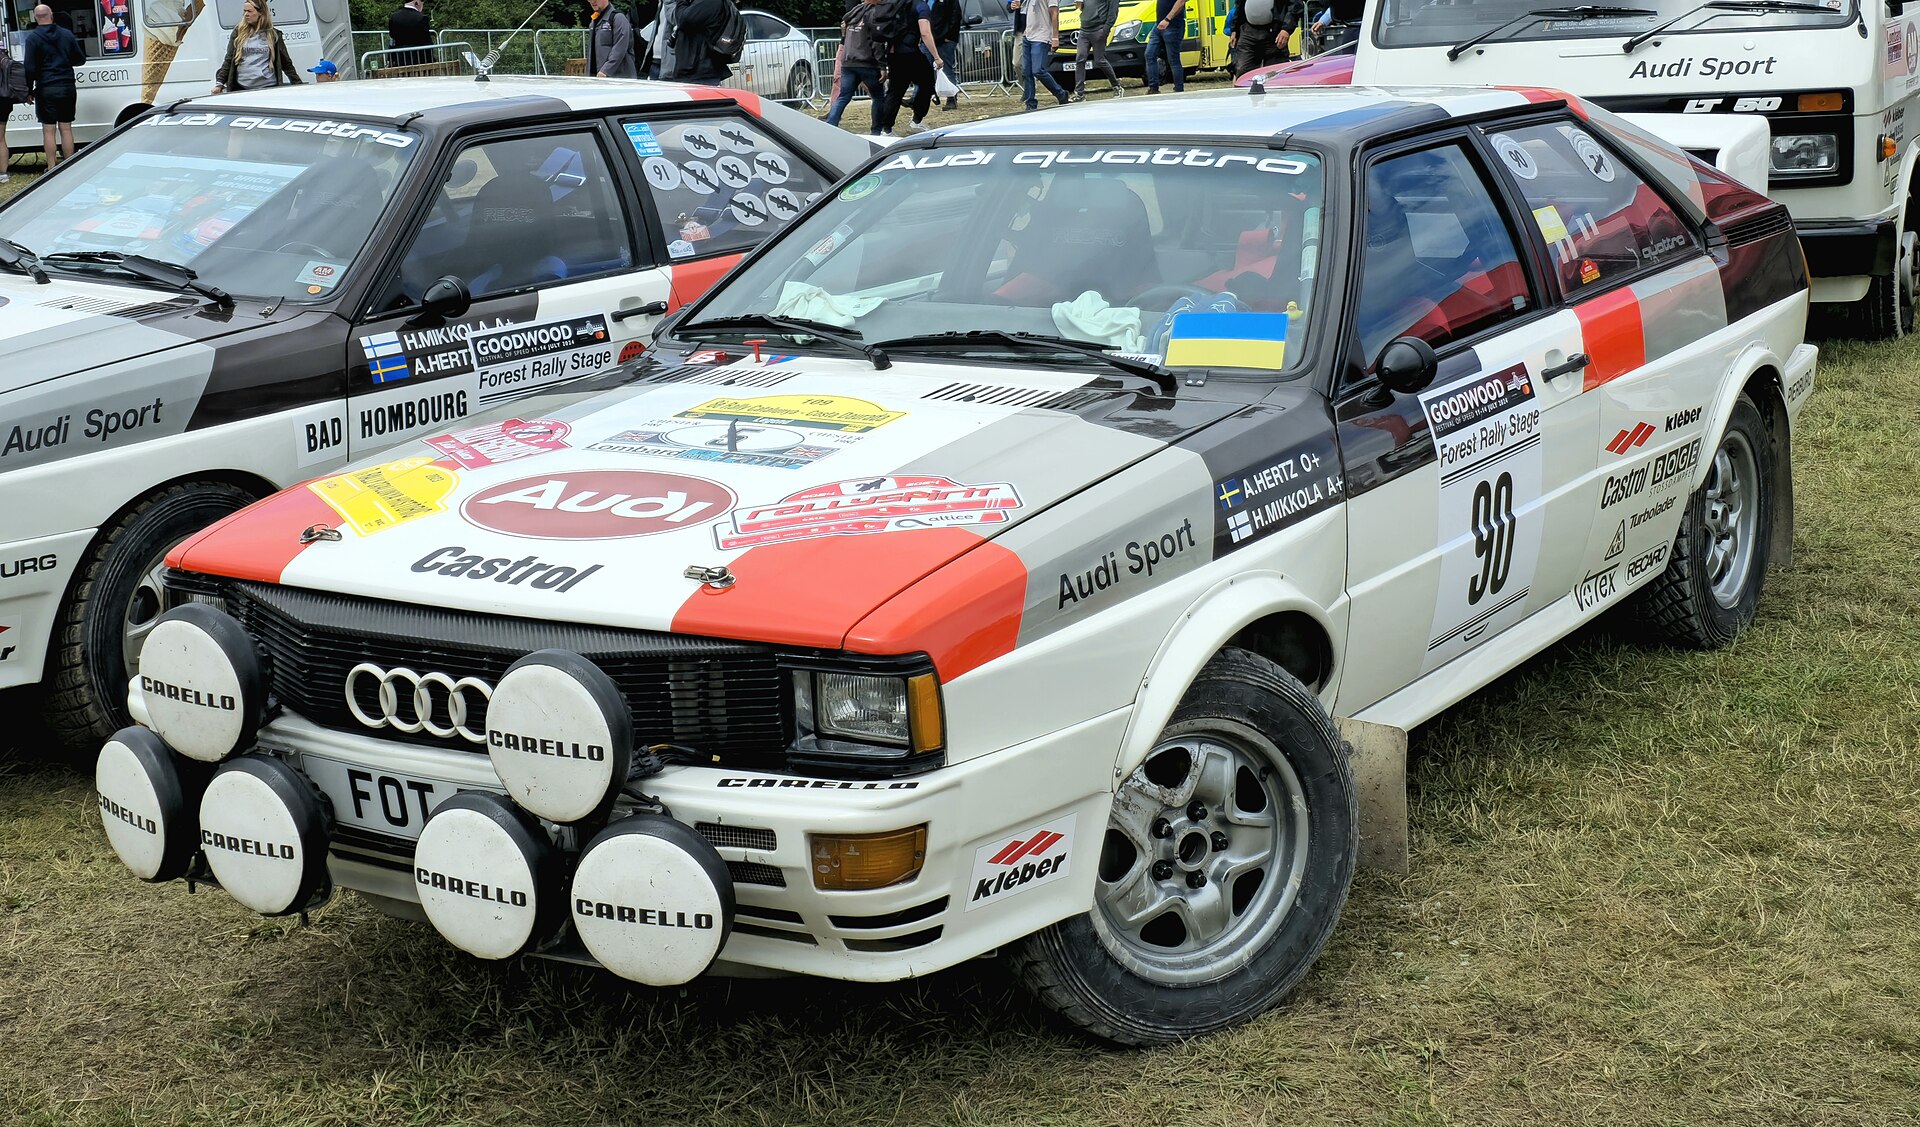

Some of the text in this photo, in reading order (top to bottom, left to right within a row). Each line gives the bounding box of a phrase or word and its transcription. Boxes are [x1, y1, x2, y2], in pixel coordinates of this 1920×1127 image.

[88, 69, 129, 83] cream
[1628, 55, 1778, 80] Audi Sport
[1682, 96, 1783, 114] LT 50
[143, 112, 415, 149] Audi quattro
[652, 164, 671, 181] 91
[869, 147, 1308, 175] Audi quattro
[1507, 149, 1529, 169] 90
[1641, 234, 1686, 261] quattro
[476, 324, 573, 357] GOODWOOD
[479, 353, 504, 363] FESTIVAL
[514, 347, 530, 357] SPEED
[531, 344, 547, 353] 11-14
[548, 341, 561, 350] JULY
[562, 339, 575, 347] 2024
[479, 350, 612, 389] Forest Rally Stage
[1430, 378, 1505, 424] GOODWOOD
[1435, 421, 1456, 433] FESTIVAL
[1462, 412, 1475, 422] SPEED
[1475, 405, 1488, 418] 11-14
[1488, 401, 1498, 413] JULY
[1498, 398, 1509, 407] 2024
[1664, 406, 1703, 433] kléber
[1, 397, 163, 457] Audi Sport
[306, 389, 468, 453] BAD HOMBOURG
[1439, 409, 1540, 468] Forest Rally Stage
[585, 442, 686, 458] Lombard
[1653, 439, 1700, 483] BOGE
[1243, 452, 1321, 500] A.HERTZ O+
[1601, 462, 1651, 511] Castrol
[476, 479, 715, 523] Audi
[928, 514, 974, 522] altice
[1252, 474, 1344, 531] H.MIKKOLA A+
[1629, 496, 1677, 530] Turbolader
[1467, 471, 1517, 607] 90
[410, 546, 605, 594] Castrol
[1058, 517, 1196, 611] Audi Sport
[1626, 544, 1668, 581] RECARO
[140, 675, 236, 712] CARELLO
[488, 729, 605, 763] CARELLO
[346, 768, 435, 828] FOT
[717, 777, 920, 790] CARELLO
[97, 791, 157, 836] CARELLO
[201, 829, 296, 861] CARELLO
[415, 866, 527, 908] CARELLO
[970, 850, 1068, 904] kléber
[575, 897, 714, 930] CARELLO
